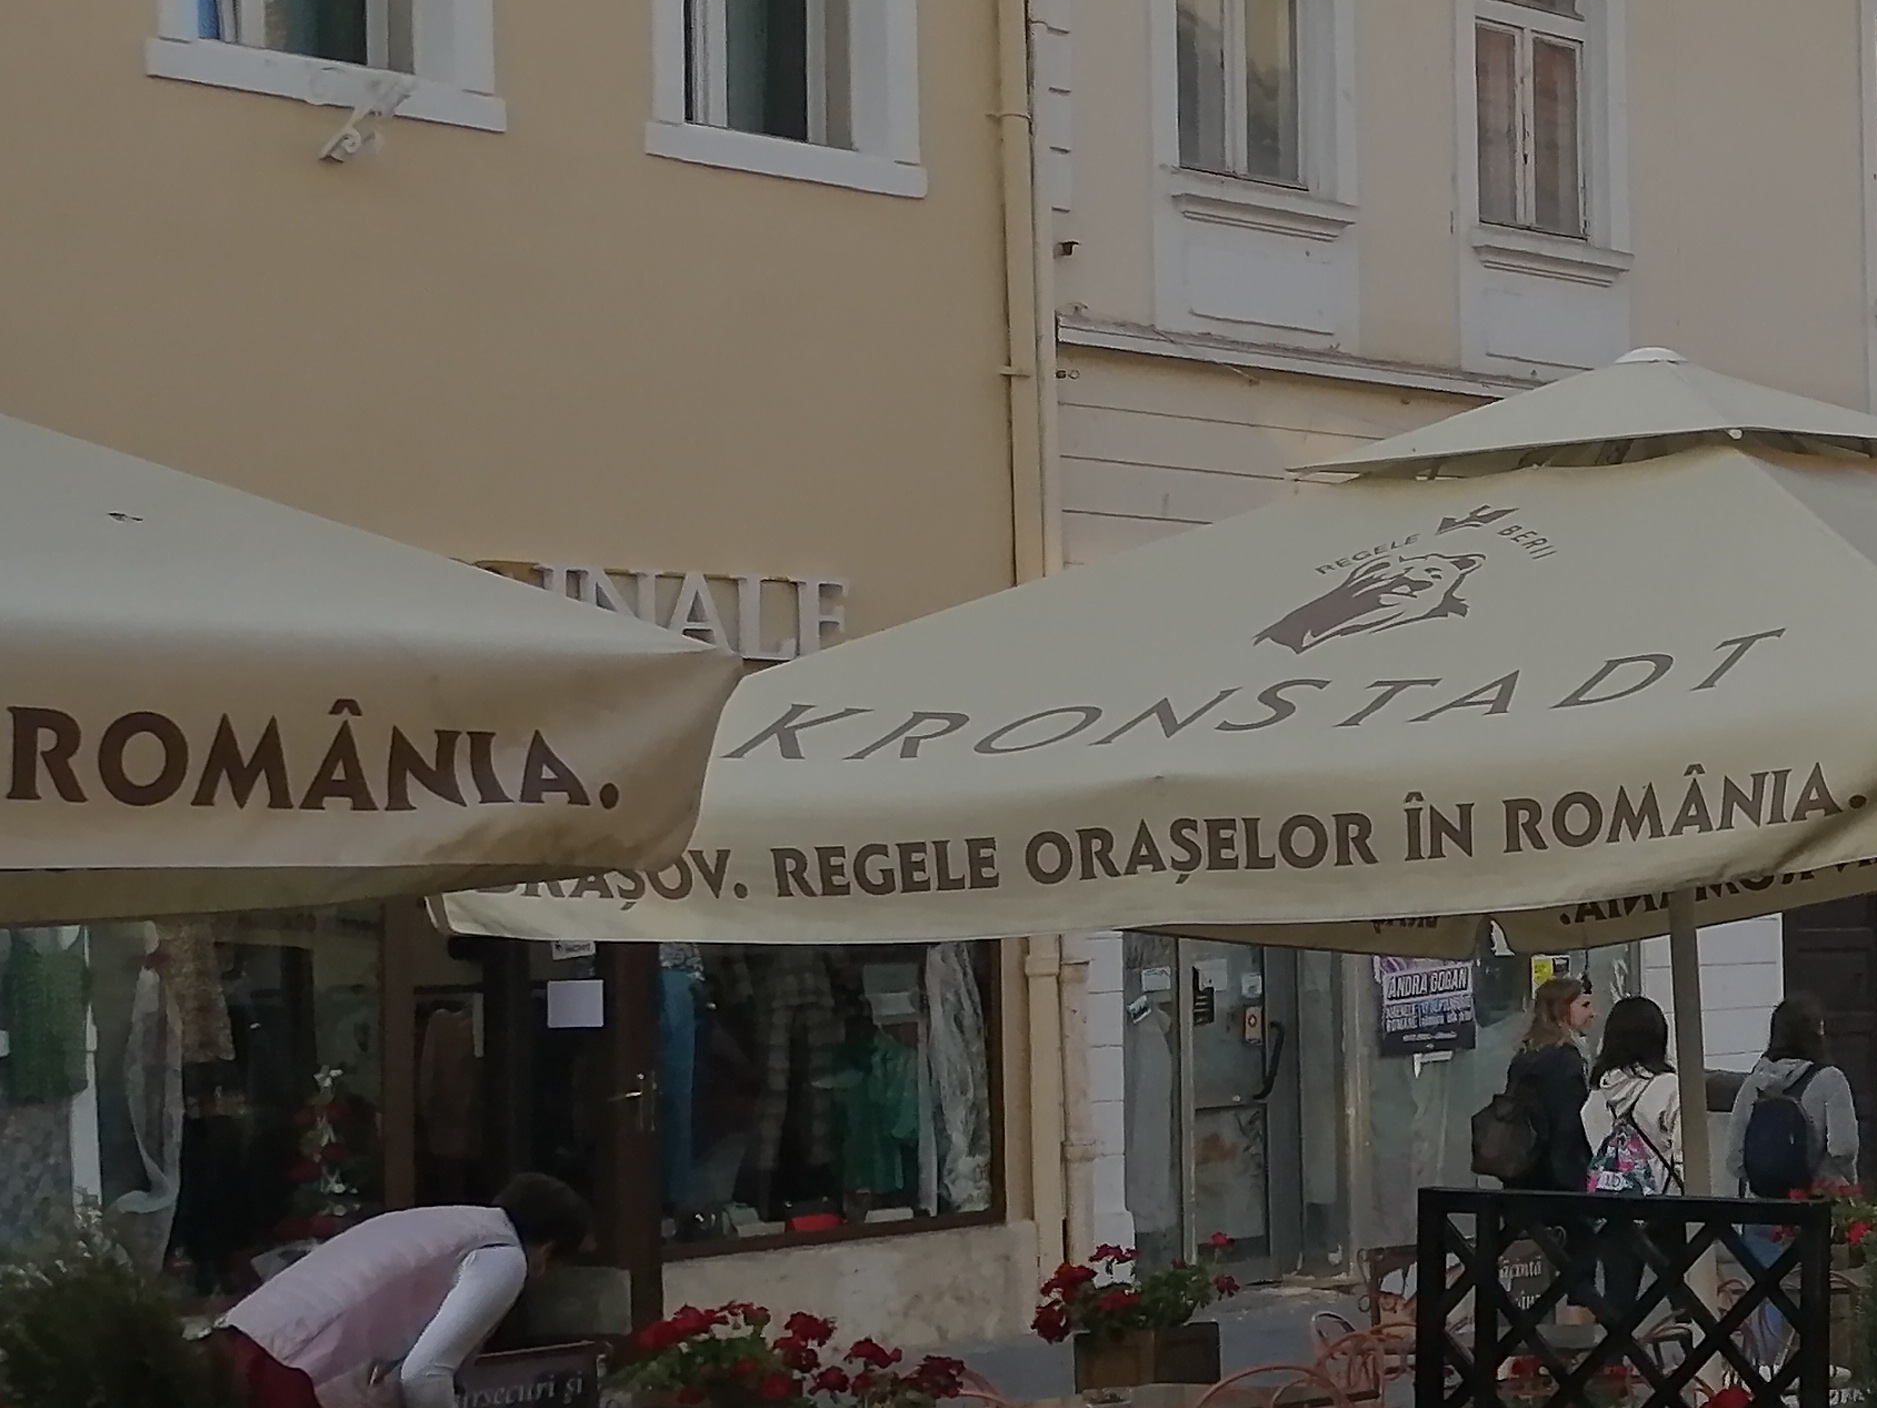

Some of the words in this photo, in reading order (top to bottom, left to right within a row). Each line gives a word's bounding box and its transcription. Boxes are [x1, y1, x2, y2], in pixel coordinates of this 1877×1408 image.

[1497, 524, 1558, 561] BERII
[718, 627, 1787, 760] KRONSTADT
[5, 698, 621, 812] ROMÂNIA.
[770, 837, 999, 898] REGELE
[1024, 812, 1380, 885] ORAȘELOR
[1403, 791, 1475, 861] ÎN
[1502, 761, 1868, 853] ROMÂNIA.
[1387, 971, 1427, 1000] ANDRA
